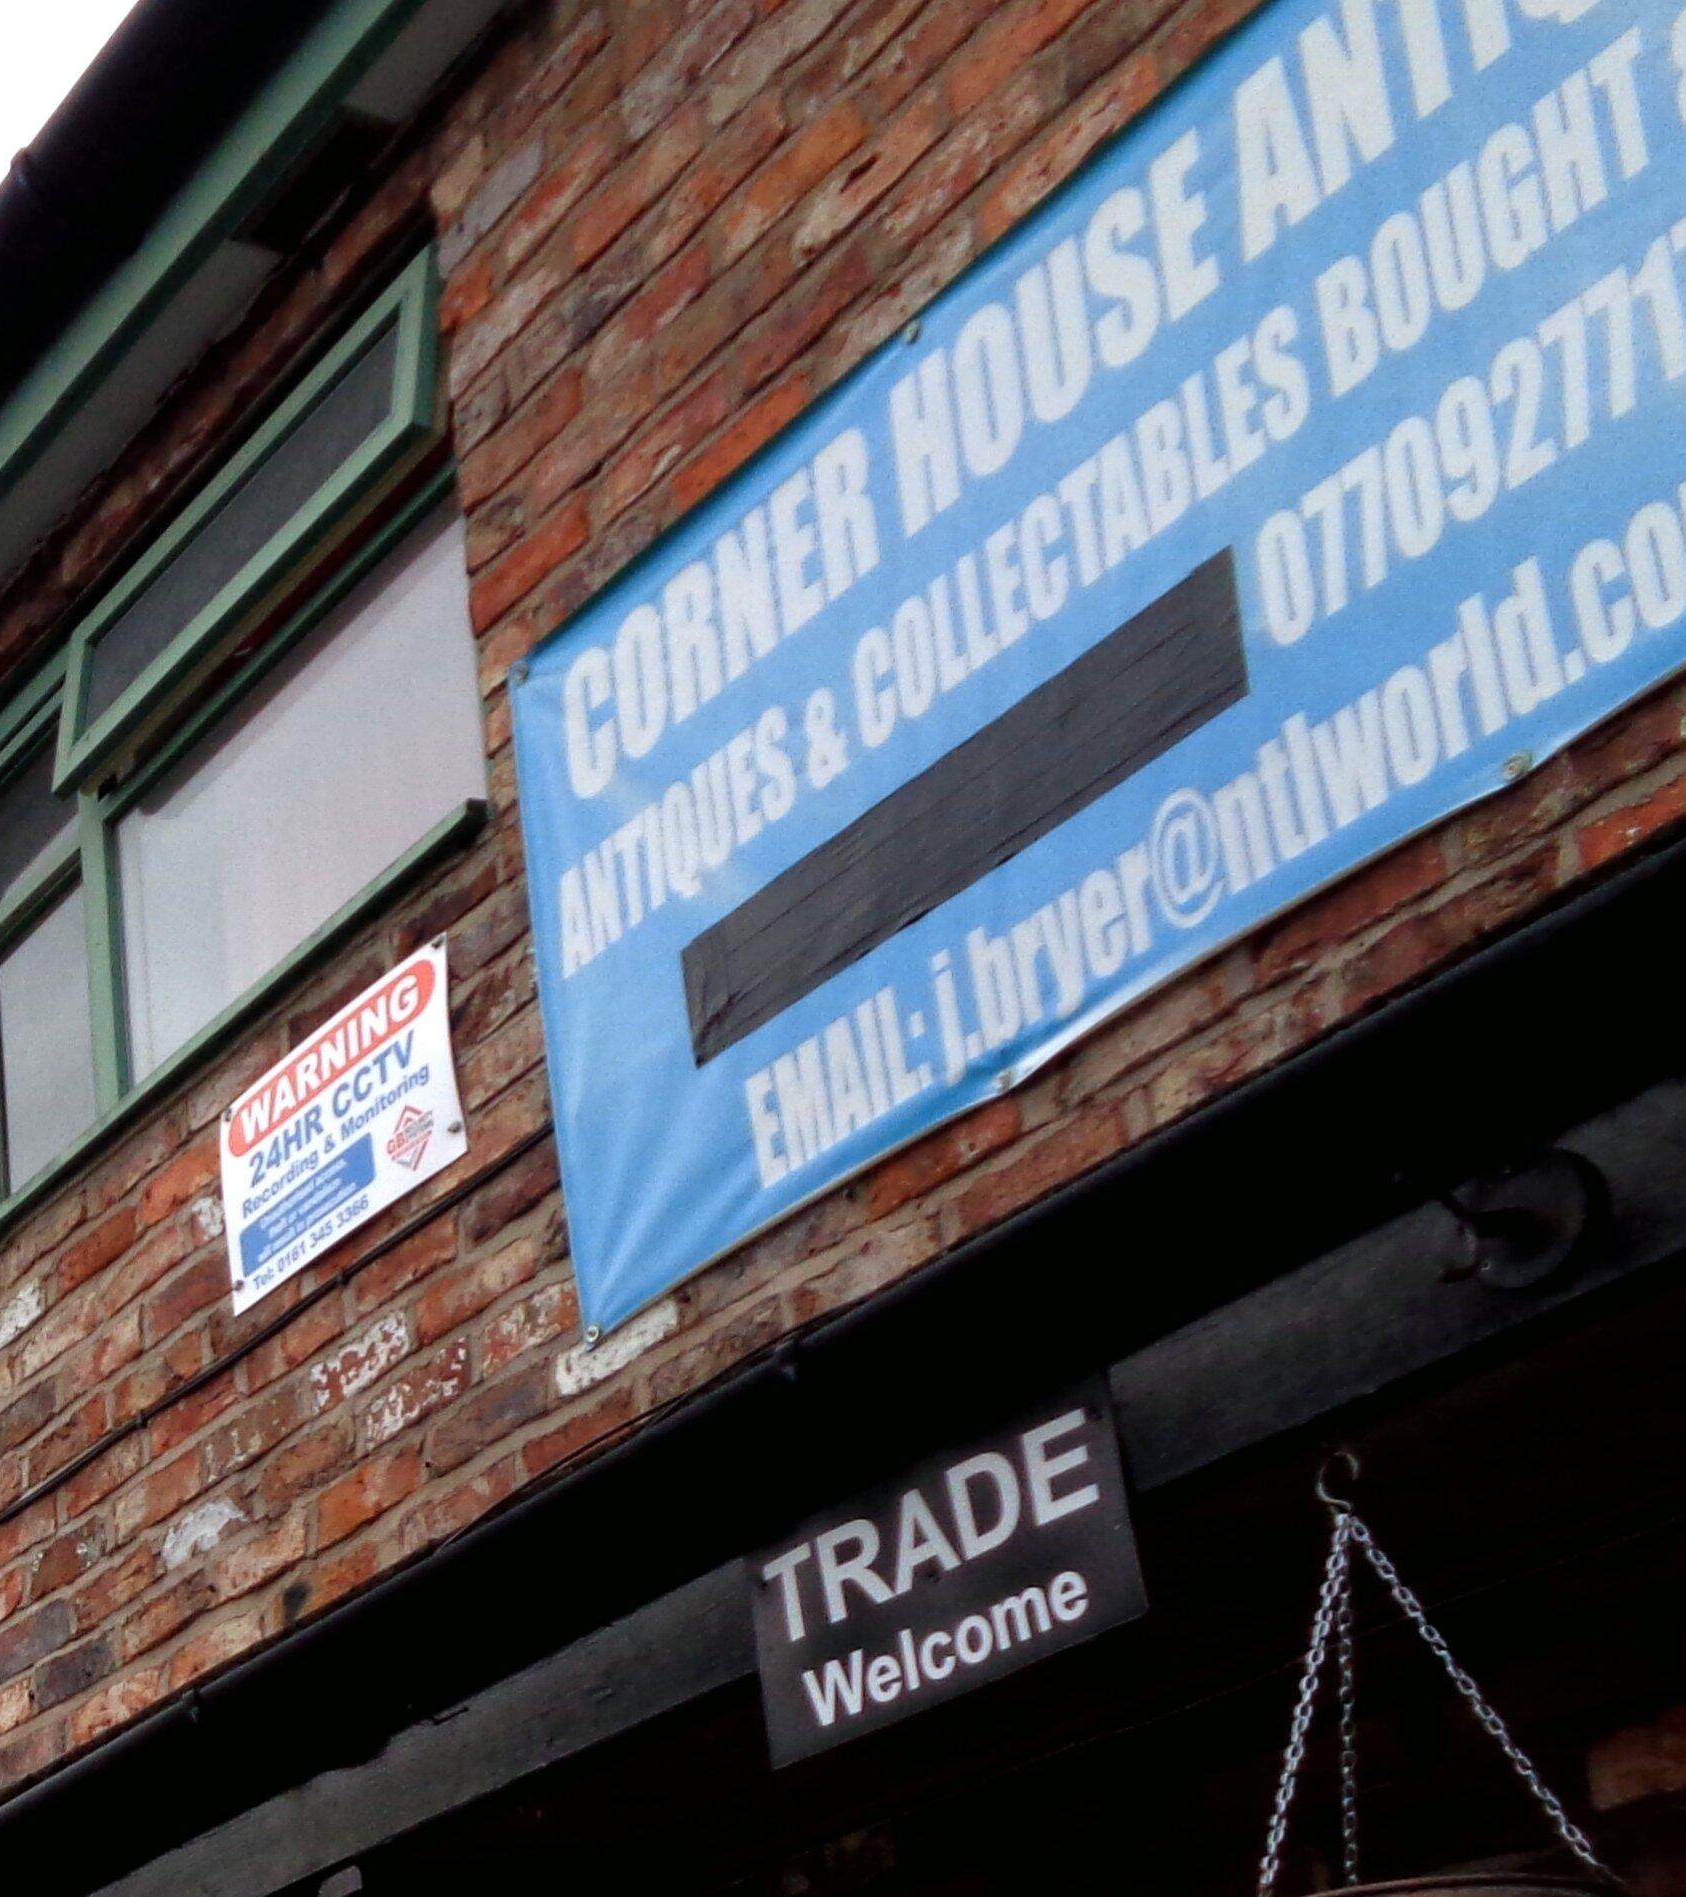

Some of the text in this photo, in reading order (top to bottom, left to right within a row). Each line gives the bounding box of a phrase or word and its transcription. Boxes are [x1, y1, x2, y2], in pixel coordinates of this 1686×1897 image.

[561, 25, 1650, 978] ANTIQUES & COLLECTABLES BOUGHT
[565, 0, 1602, 798] CORNER HOUSE ANT
[1253, 215, 1686, 648] 077092771
[745, 480, 1686, 1189] EMAIL: j.bryer@ntlworld.co
[240, 974, 420, 1143] WARNING
[242, 1152, 319, 1219] Recording
[340, 1065, 430, 1140] Monitoring
[249, 1030, 414, 1188] 24HR CCTV
[762, 1408, 1100, 1643] TRADE
[801, 1570, 1088, 1727] Welcome
